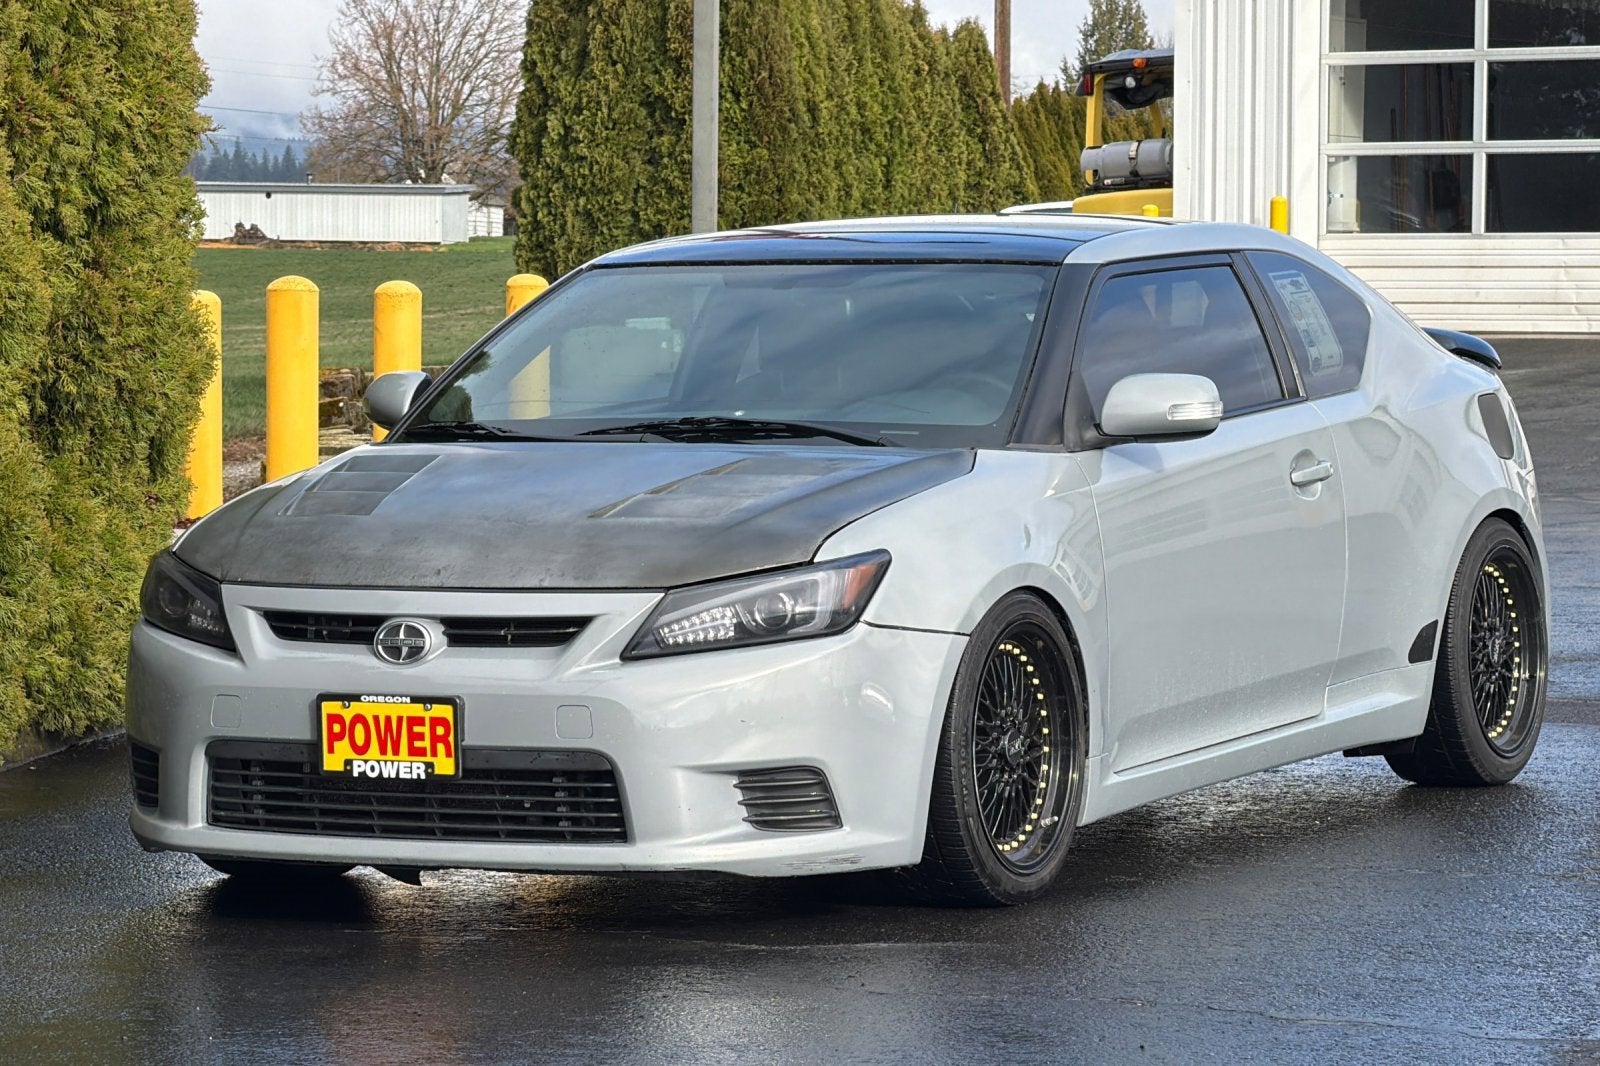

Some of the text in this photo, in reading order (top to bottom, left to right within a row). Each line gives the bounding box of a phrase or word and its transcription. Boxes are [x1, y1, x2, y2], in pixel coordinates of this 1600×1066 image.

[360, 694, 411, 703] OREGON
[326, 712, 453, 758] POWER
[352, 760, 426, 779] POWER
